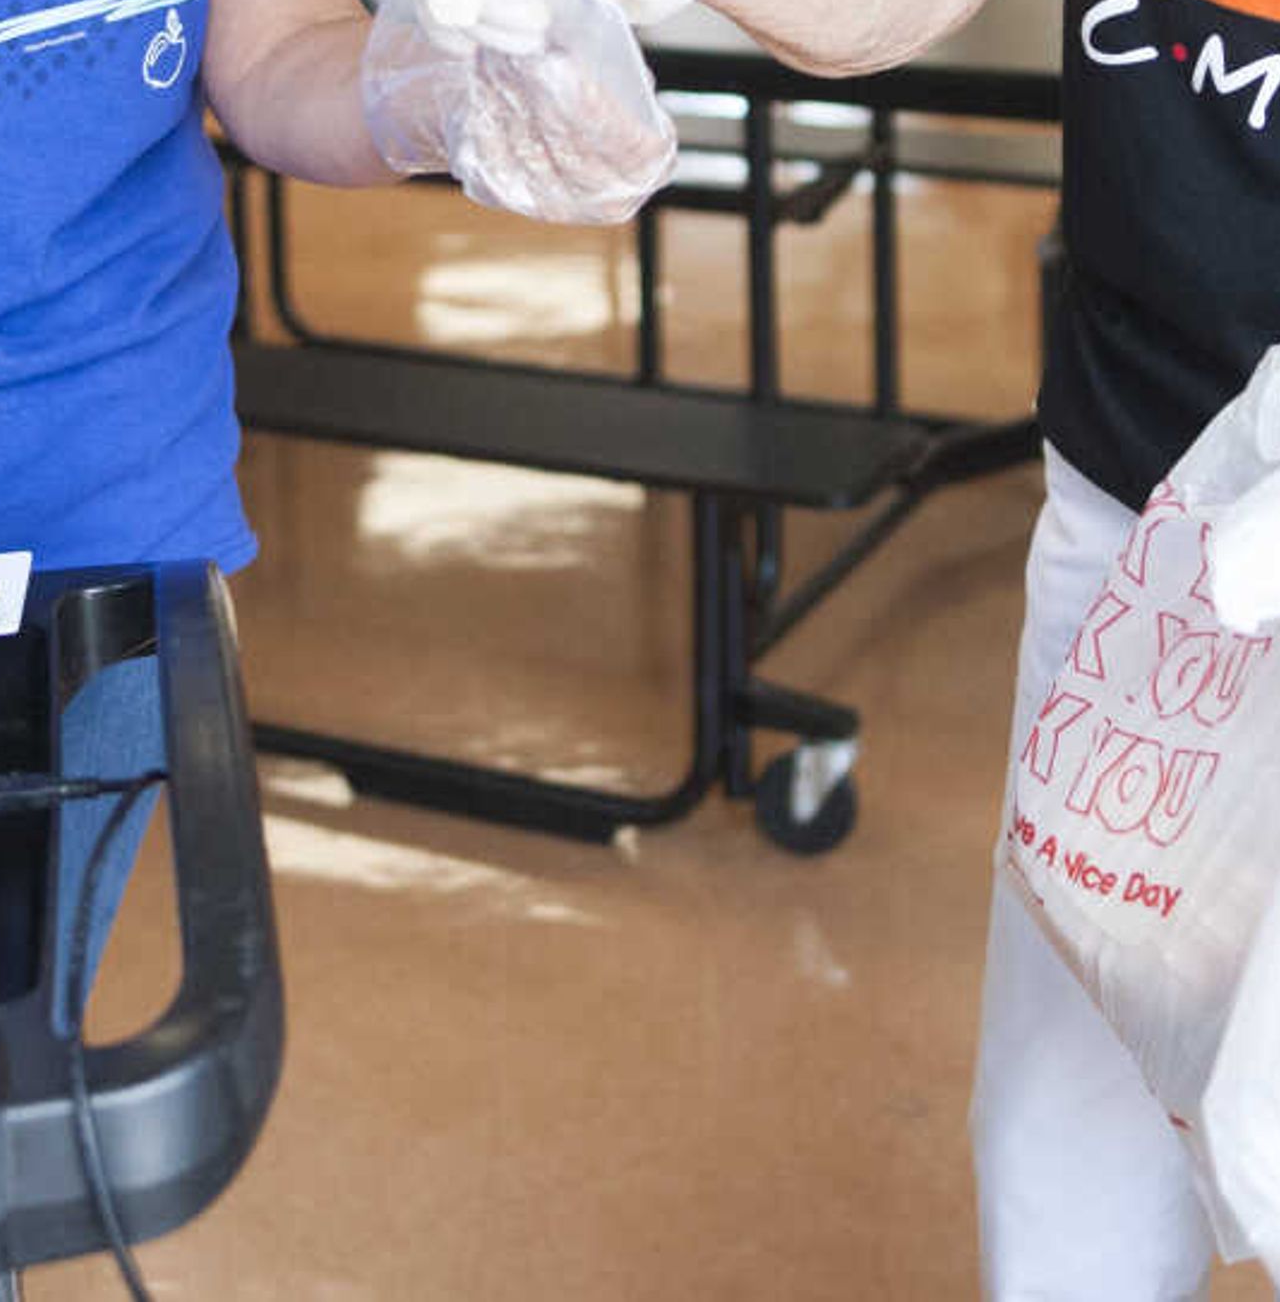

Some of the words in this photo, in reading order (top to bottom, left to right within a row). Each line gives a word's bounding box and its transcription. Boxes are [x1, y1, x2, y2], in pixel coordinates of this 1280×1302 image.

[1064, 716, 1221, 849] YOU
[1036, 835, 1060, 868] A
[1123, 871, 1183, 918] Day
